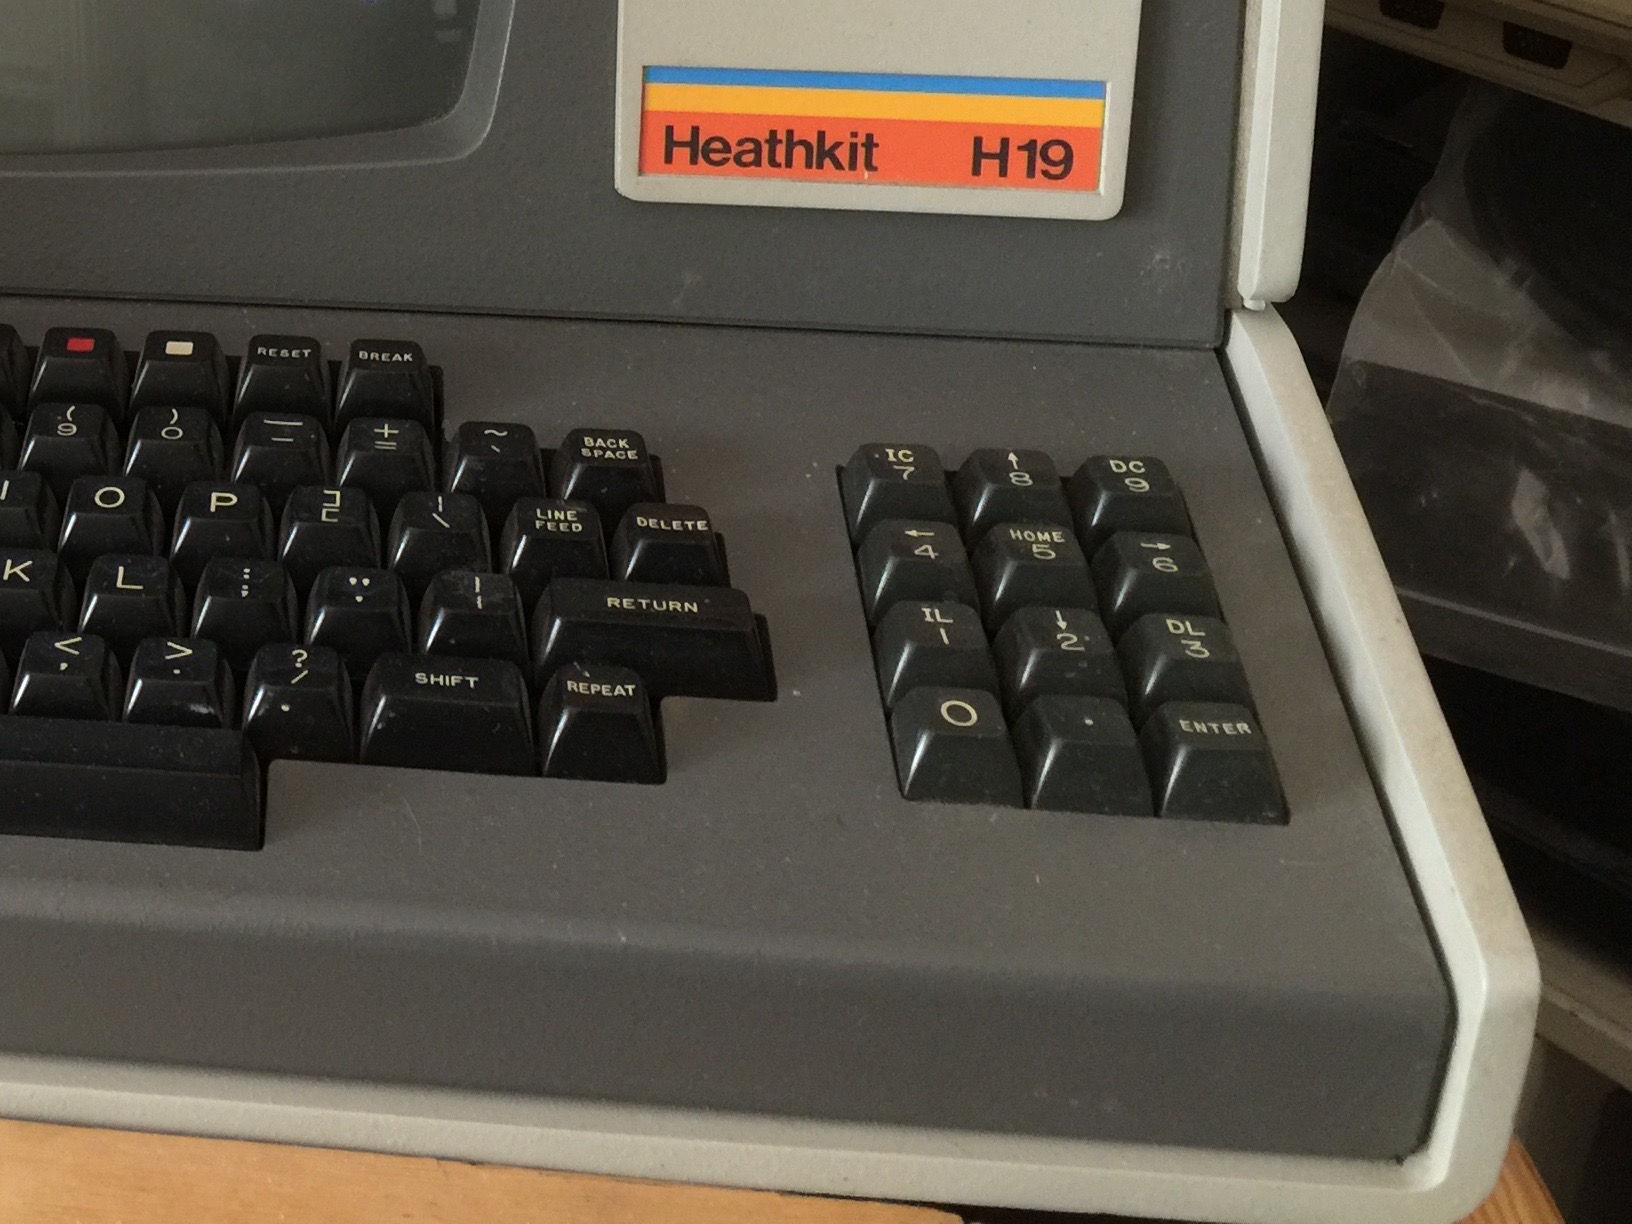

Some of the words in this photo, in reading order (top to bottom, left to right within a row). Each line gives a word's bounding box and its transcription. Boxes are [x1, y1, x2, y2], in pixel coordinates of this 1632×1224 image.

[663, 124, 879, 173] Heathkit
[257, 346, 312, 358] RESET
[358, 350, 413, 362] BREAK
[56, 422, 78, 437] 9
[580, 436, 630, 448] BACK
[580, 448, 638, 460] SPACE
[884, 448, 914, 463] IC
[892, 465, 915, 481] 7
[1108, 459, 1146, 474] DC
[1008, 471, 1034, 487] 8
[1124, 477, 1150, 493] 9
[94, 486, 125, 508] O
[209, 491, 238, 513] P
[535, 509, 578, 521] LINE
[535, 520, 583, 532] FEED
[636, 516, 709, 531] DELETE
[1009, 528, 1065, 544] HOME
[913, 544, 939, 560] 4
[1031, 543, 1057, 560] 5
[2, 558, 33, 582] K
[1152, 556, 1179, 573] 6
[116, 565, 144, 590] L
[606, 596, 698, 613] RETURN
[921, 607, 954, 624] IL
[1165, 618, 1206, 637] DL
[1056, 632, 1085, 651] 2
[1180, 639, 1211, 659] 3
[414, 672, 479, 689] SHIFT
[566, 680, 636, 697] REPEAT
[1178, 719, 1252, 735] ENTER
